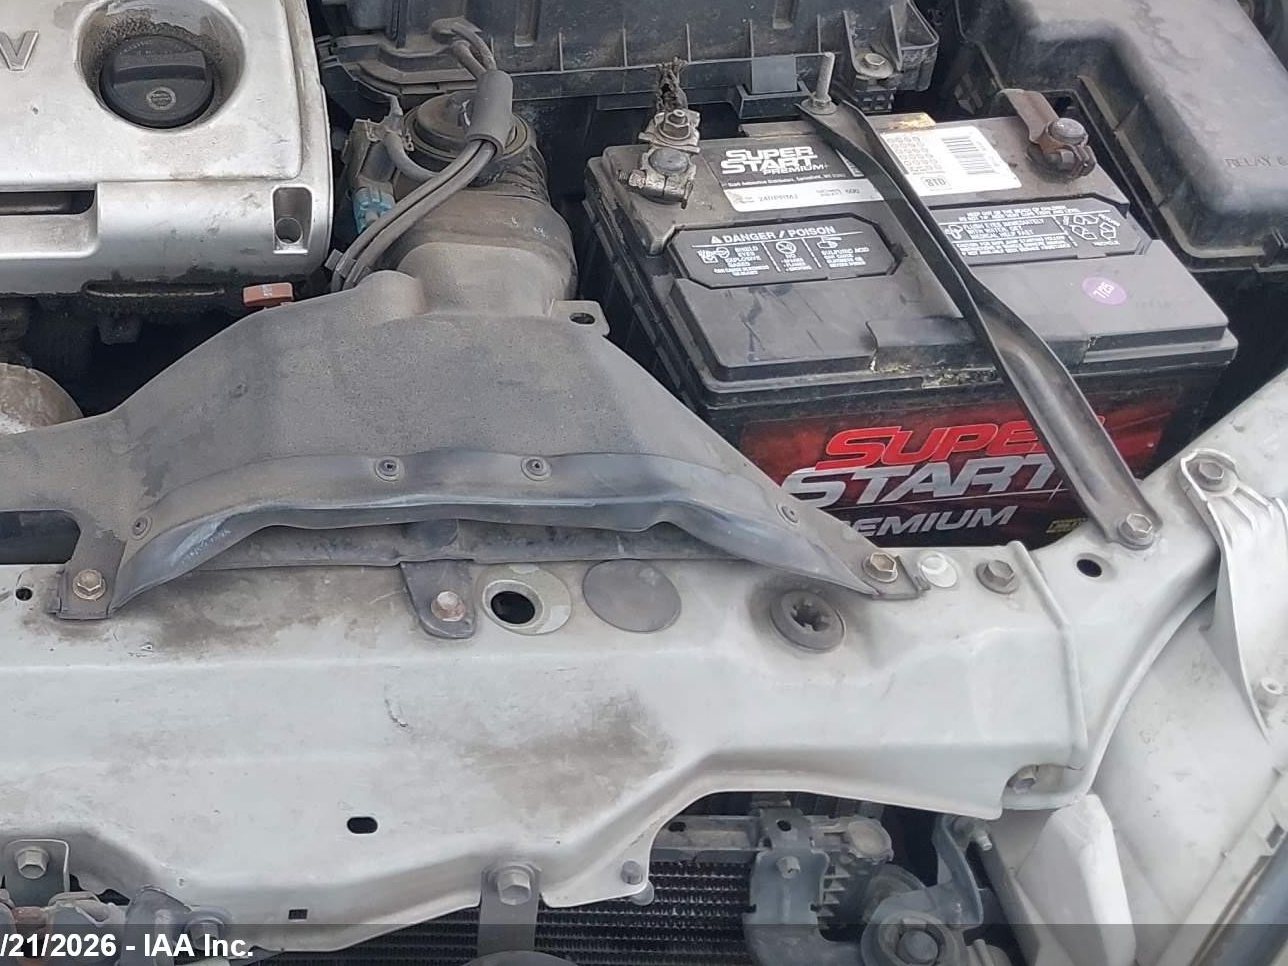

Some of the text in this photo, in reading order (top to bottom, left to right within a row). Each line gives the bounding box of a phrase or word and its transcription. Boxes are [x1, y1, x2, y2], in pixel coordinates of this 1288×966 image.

[725, 146, 814, 160] SUPER
[720, 155, 818, 175] START
[763, 164, 824, 175] PREMIUM
[722, 231, 776, 243] DANGER
[789, 226, 836, 237] POISON
[814, 420, 1047, 471] SUPE
[780, 453, 1058, 509] START
[840, 505, 1018, 537] EMIUM
